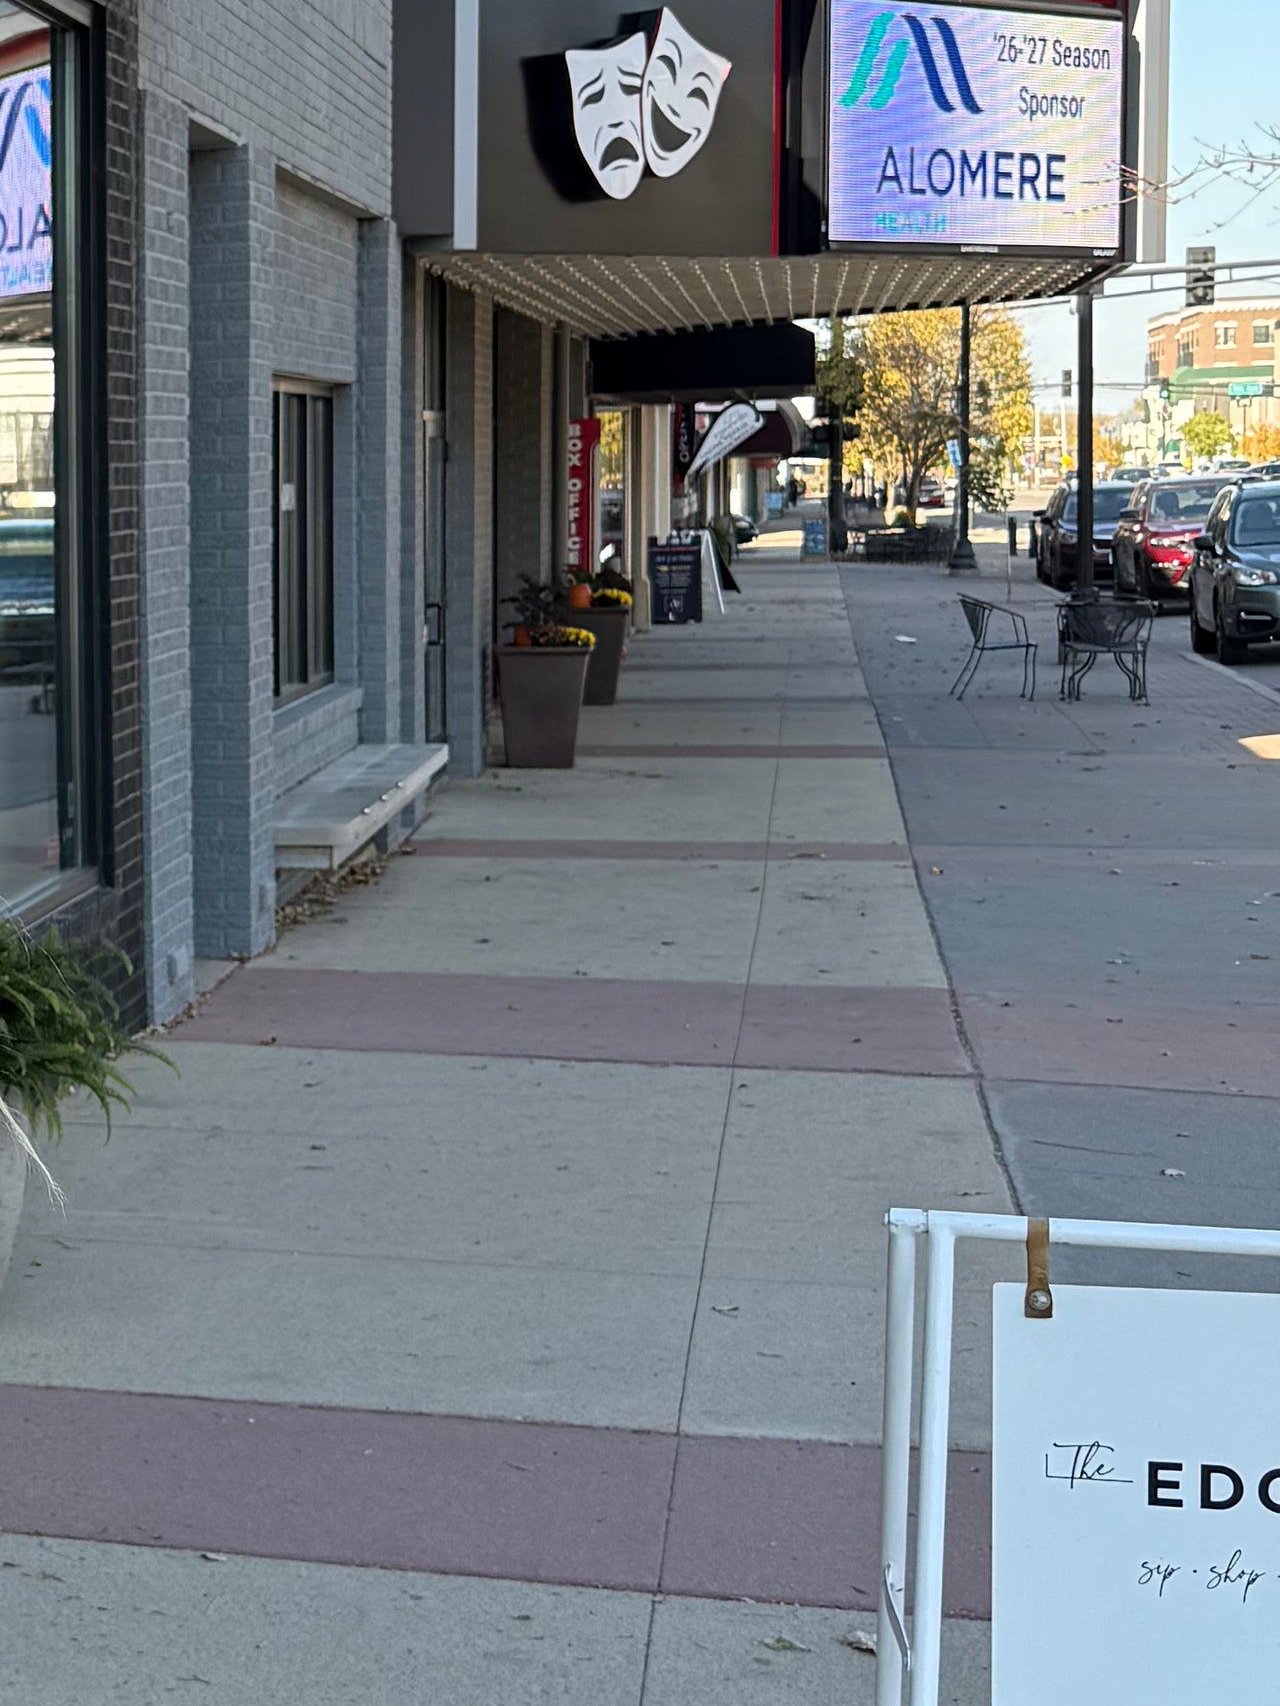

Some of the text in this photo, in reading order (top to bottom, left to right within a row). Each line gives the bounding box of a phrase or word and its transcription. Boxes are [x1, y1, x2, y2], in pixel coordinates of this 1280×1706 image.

[1051, 39, 1111, 71] Season
[1018, 85, 1086, 121] Sponsor
[876, 145, 1067, 202] ALOMERE
[567, 423, 583, 566] BOX OFFICE
[1052, 1440, 1116, 1489] The
[1137, 1548, 1266, 1604] sip shop
